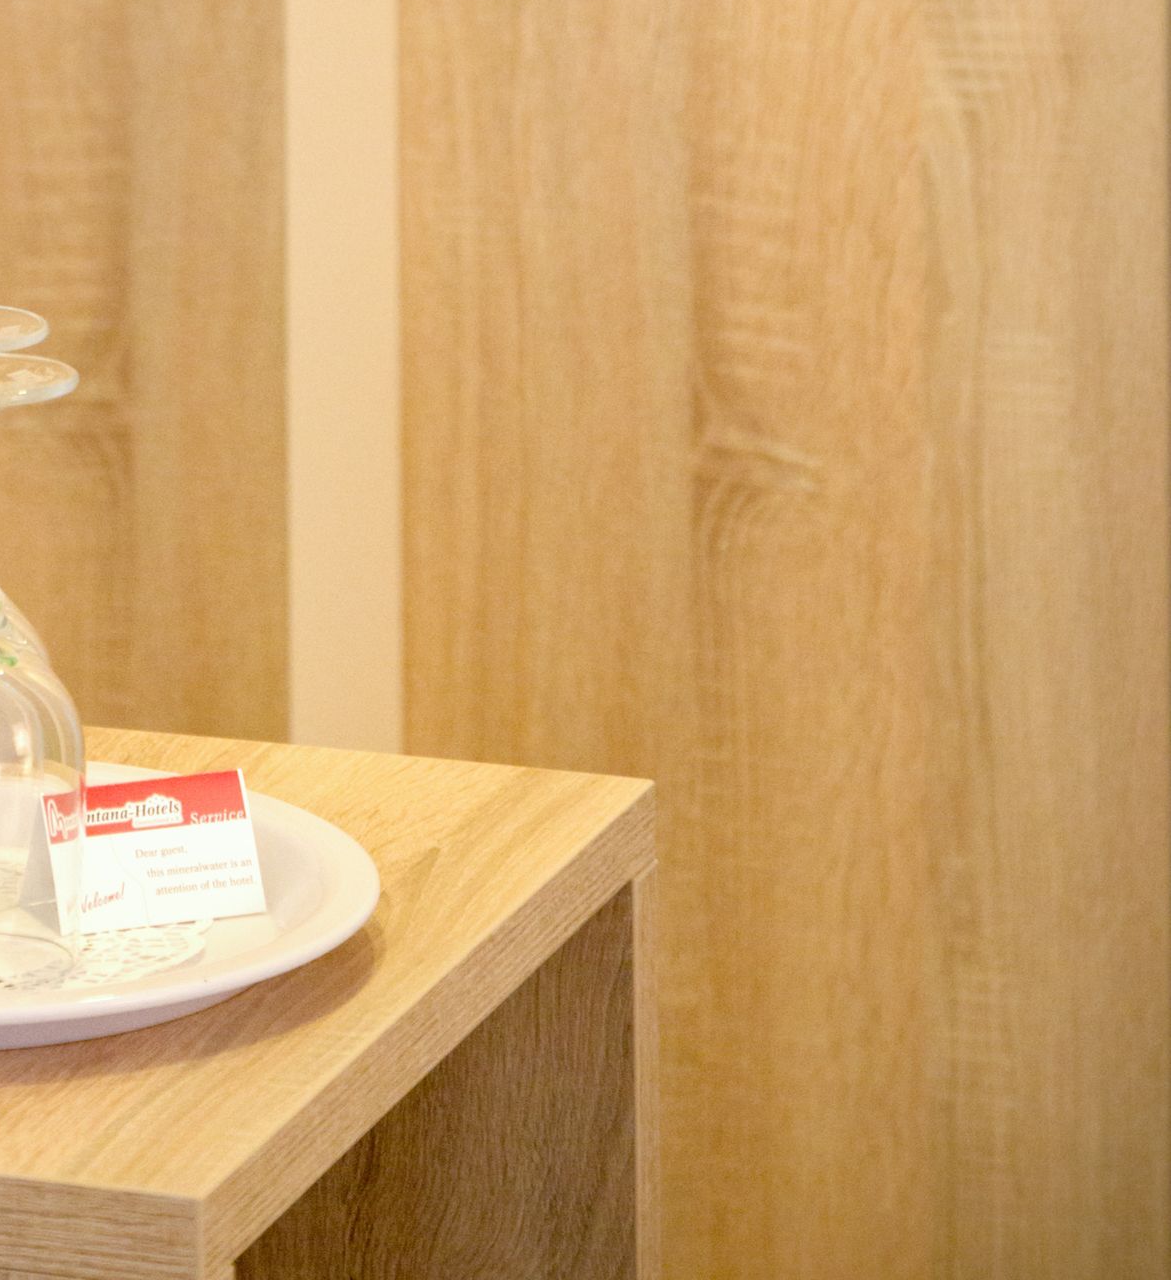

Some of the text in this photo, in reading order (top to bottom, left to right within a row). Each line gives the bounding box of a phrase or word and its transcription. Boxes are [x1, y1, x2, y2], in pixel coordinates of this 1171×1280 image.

[190, 808, 244, 825] Service
[135, 847, 158, 858] Dear
[147, 858, 253, 878] this mineralwater is an
[155, 883, 198, 896] attention
[200, 879, 211, 890] of
[212, 878, 227, 890] the
